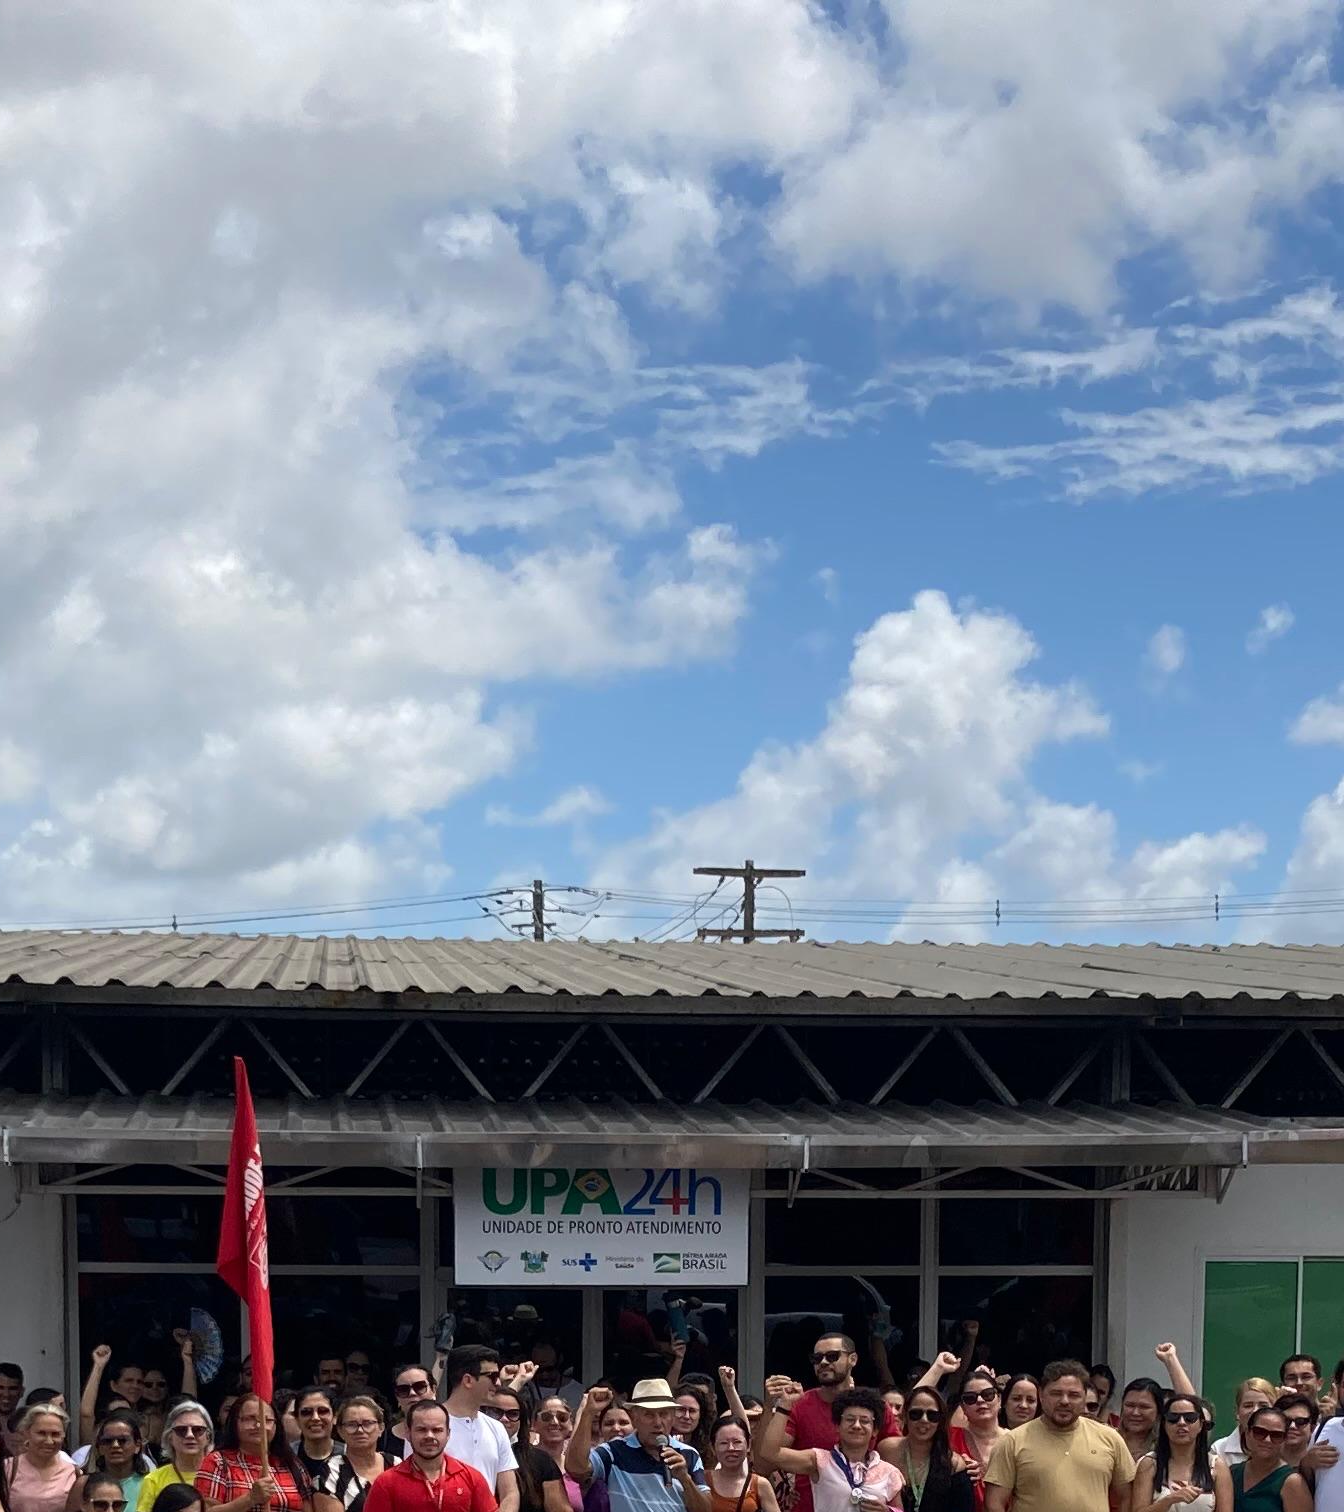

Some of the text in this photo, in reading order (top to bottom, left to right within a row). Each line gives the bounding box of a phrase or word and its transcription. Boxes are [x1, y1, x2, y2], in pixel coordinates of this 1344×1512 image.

[482, 1220, 722, 1235] UNIDADE DE PRONTO ATENDIMENTO
[562, 1258, 578, 1266] SUS
[682, 1259, 727, 1270] BRASIL
